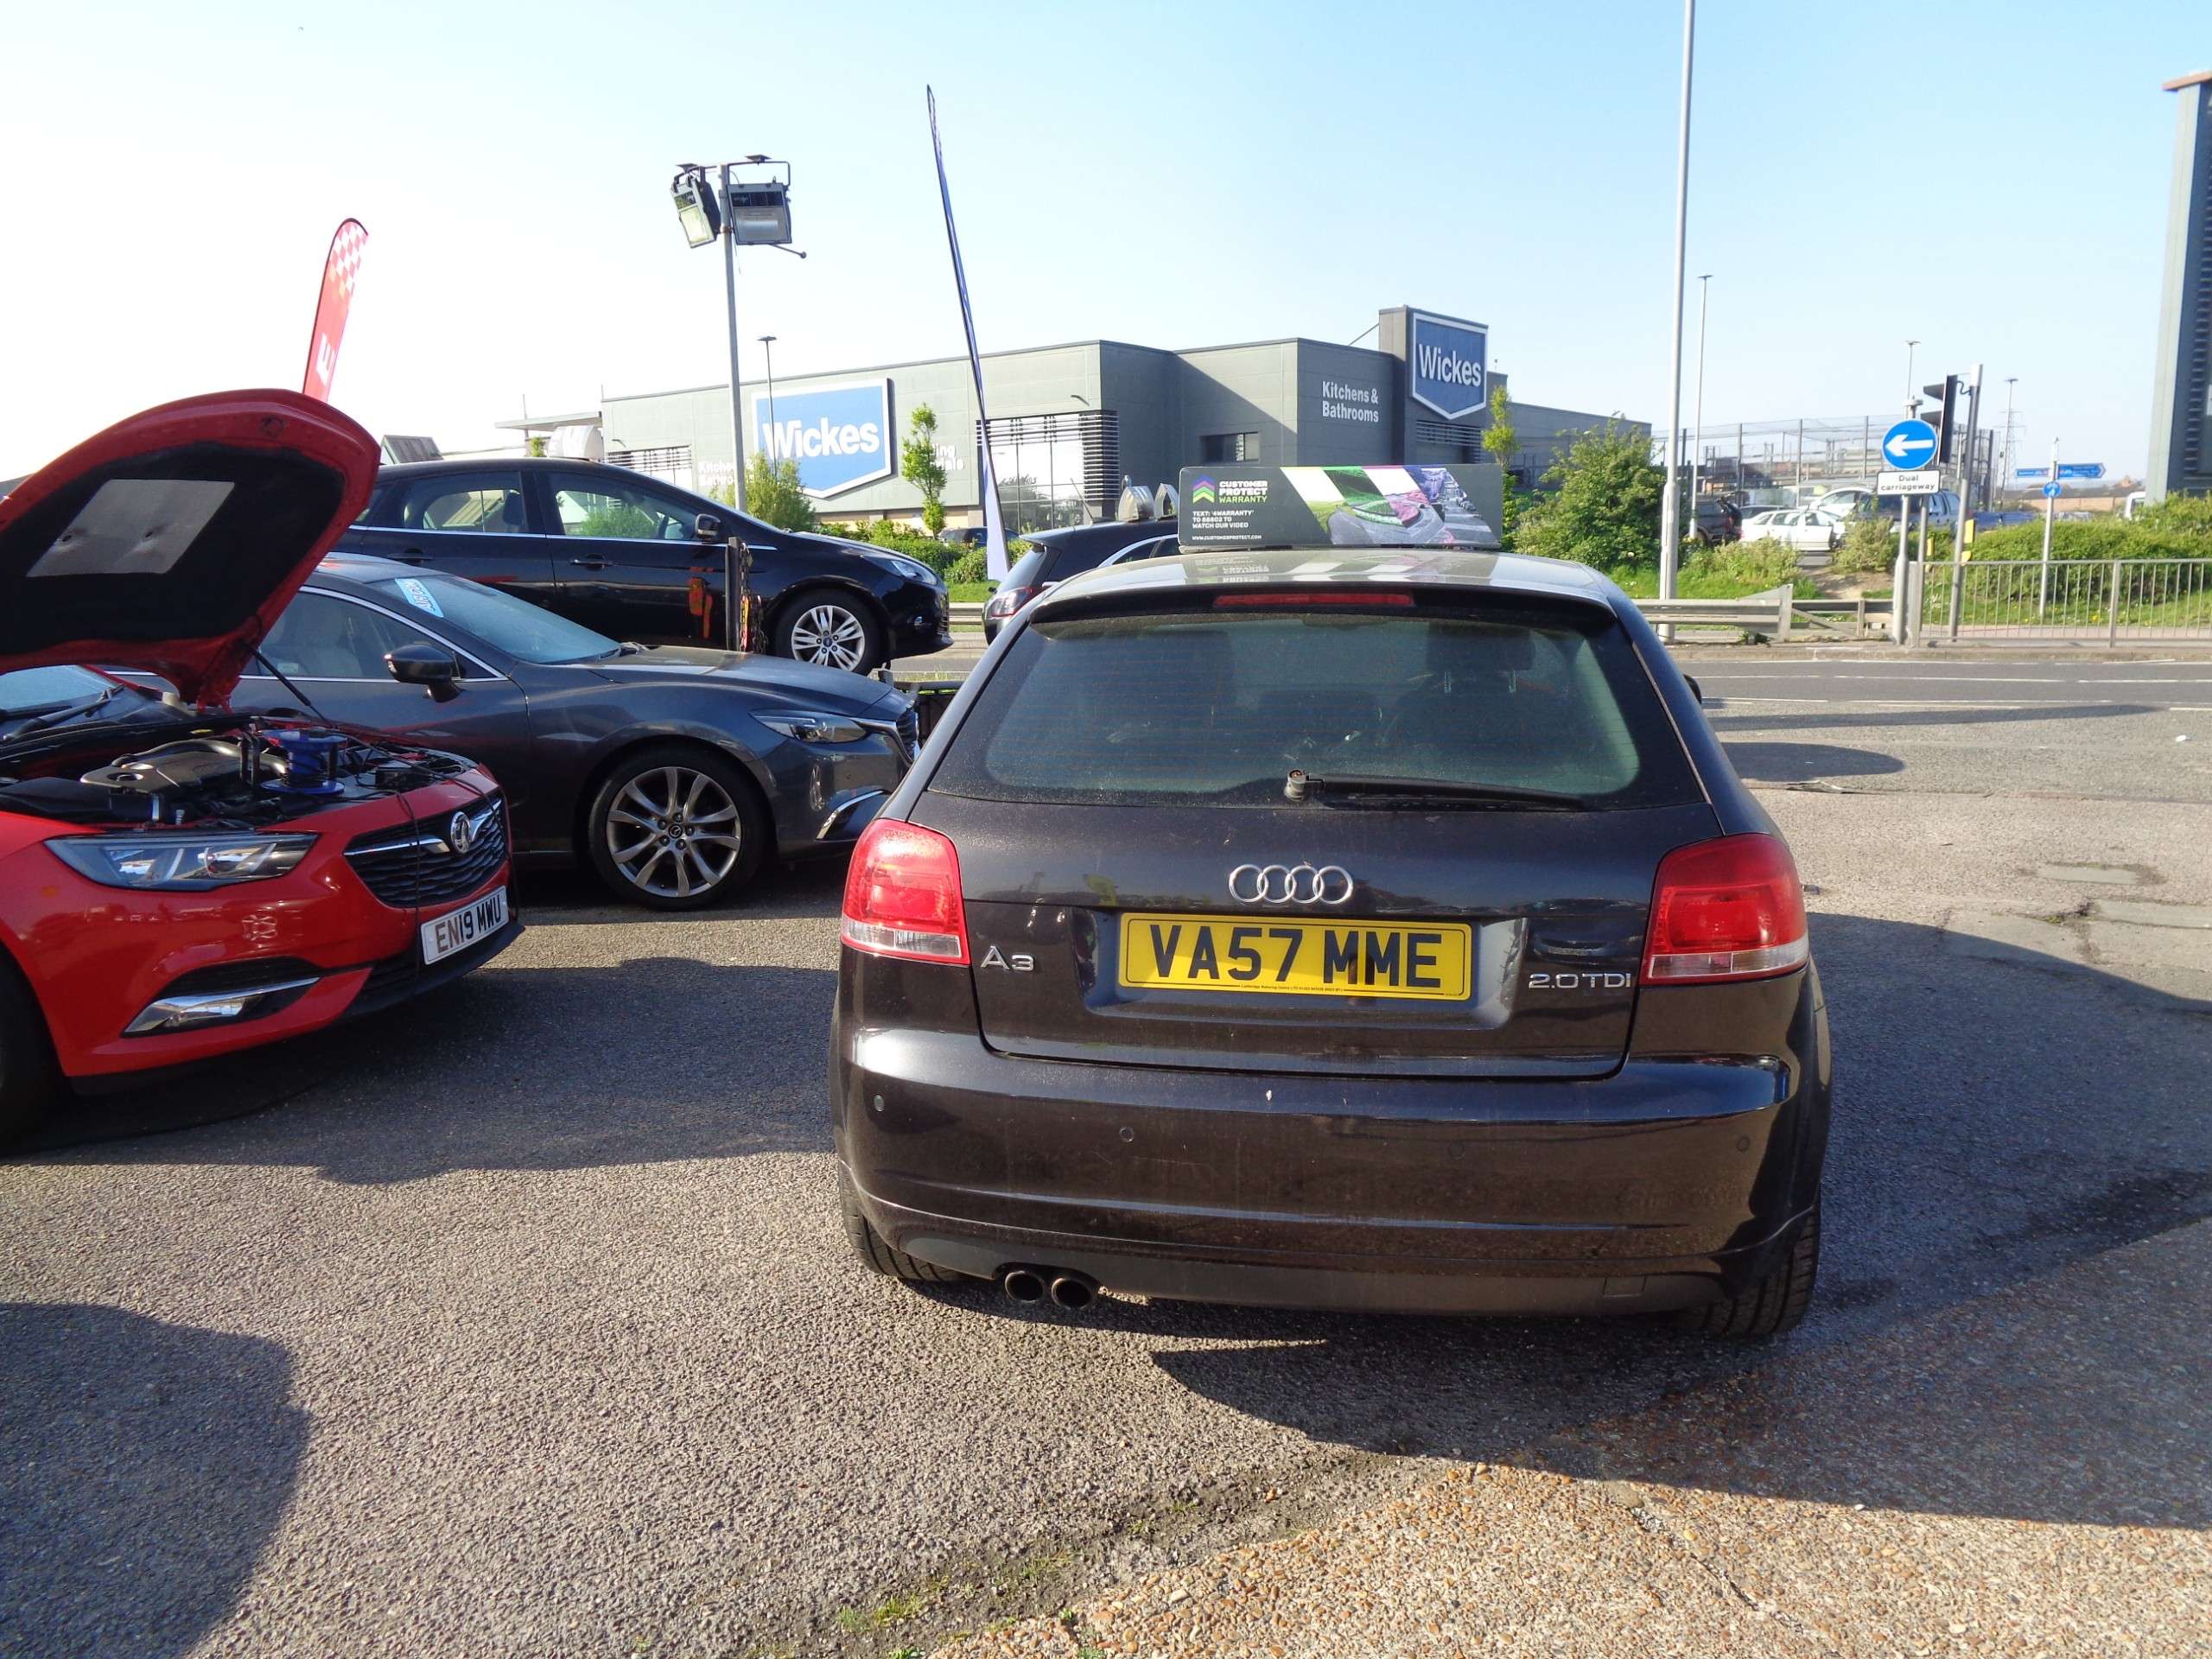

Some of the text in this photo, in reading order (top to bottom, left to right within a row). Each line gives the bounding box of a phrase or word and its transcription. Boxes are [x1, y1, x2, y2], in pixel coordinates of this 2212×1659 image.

[1418, 343, 1482, 387] Wickes
[1322, 381, 1378, 404] Kitchens &
[1322, 401, 1378, 423] Bathrooms
[762, 417, 880, 461] Wickes
[435, 911, 474, 953] EN19
[981, 945, 1034, 971] A3
[1149, 925, 1442, 988] VA57 MME
